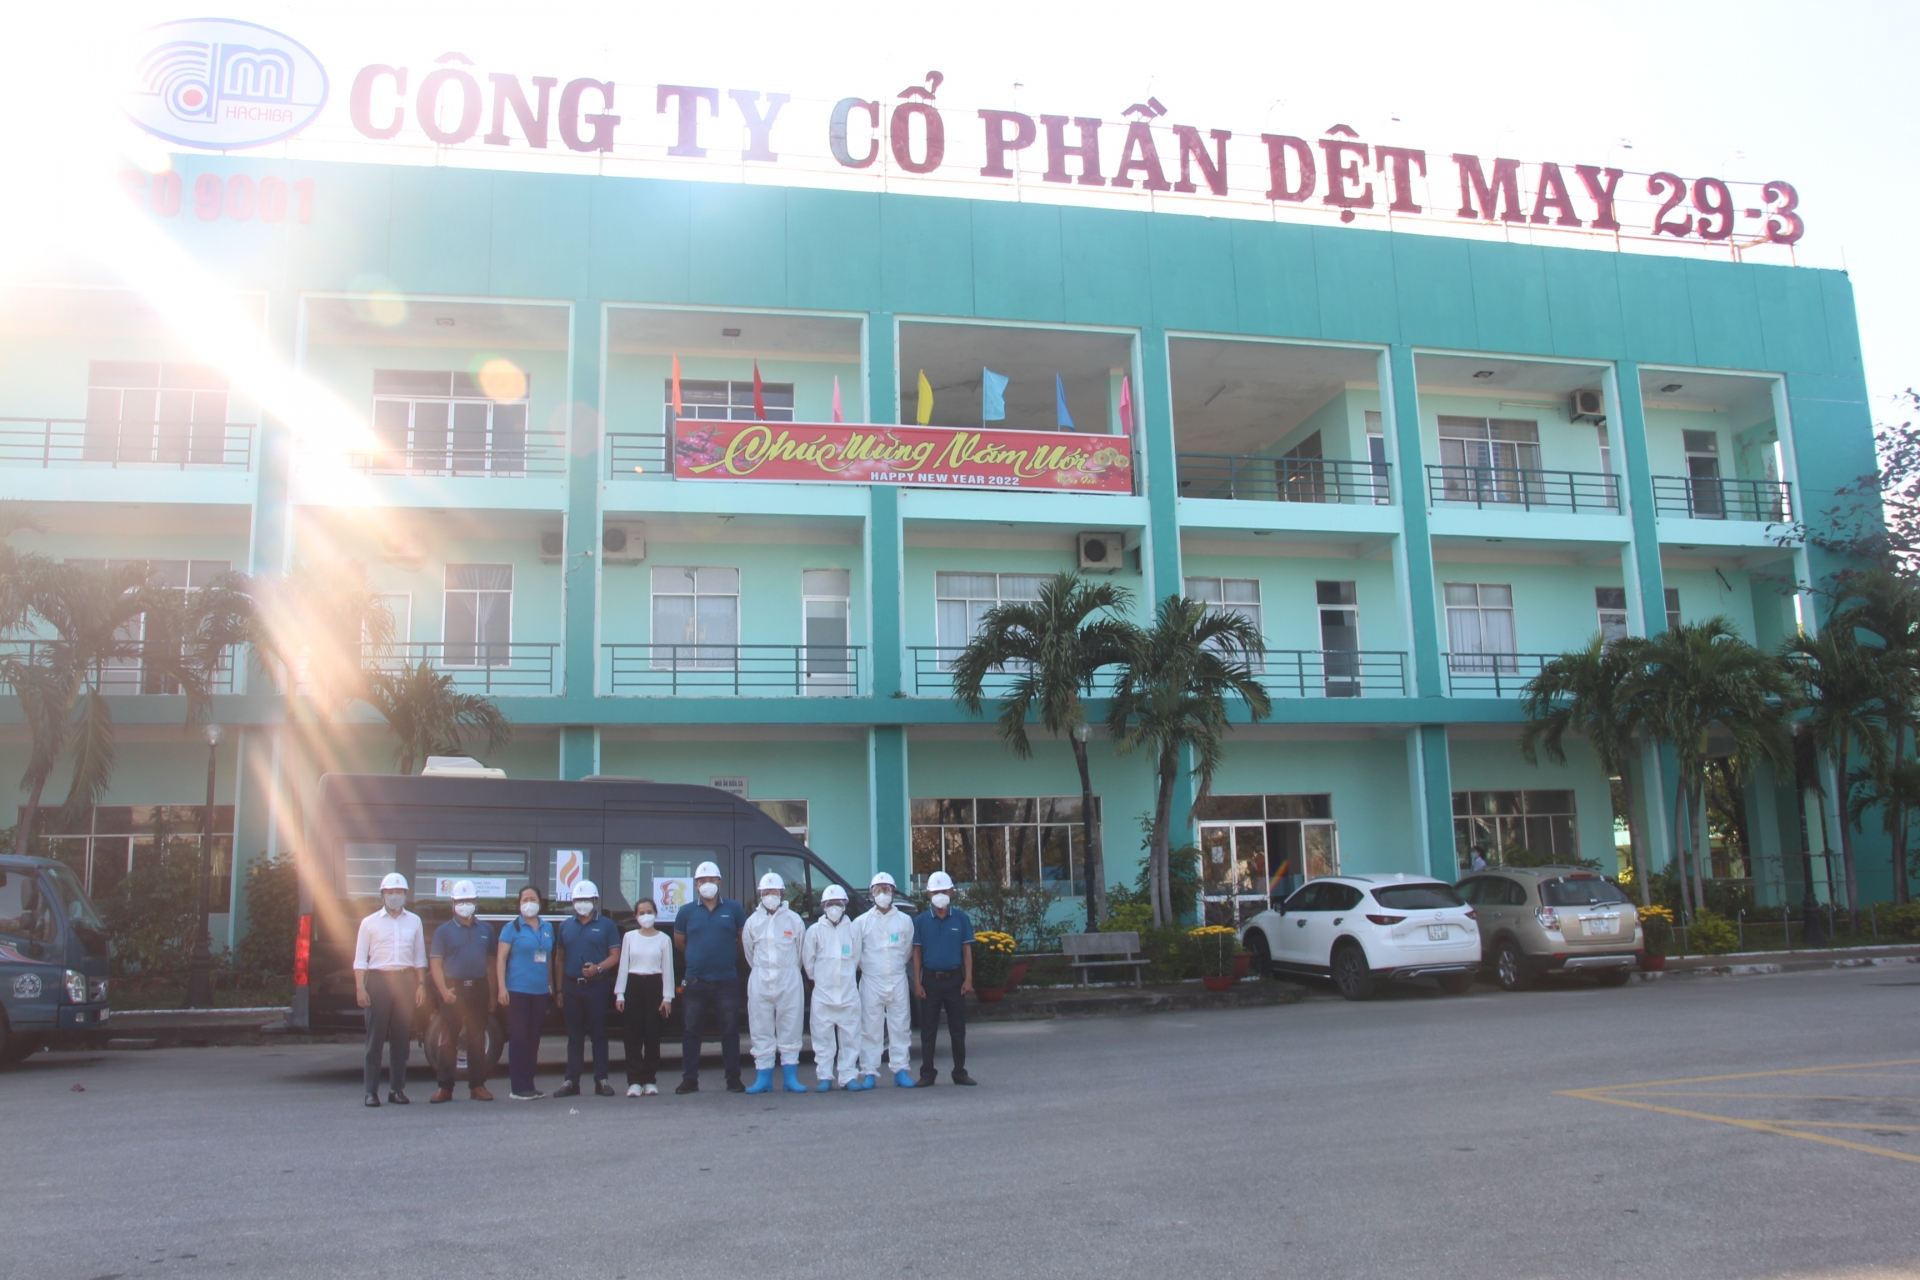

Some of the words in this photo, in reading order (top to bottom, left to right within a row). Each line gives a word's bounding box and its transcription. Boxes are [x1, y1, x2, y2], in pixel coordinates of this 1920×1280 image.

[225, 105, 293, 123] HACHIBA
[349, 51, 621, 153] CÔNG
[656, 84, 790, 162] TY
[828, 70, 945, 174] CỔ
[978, 96, 1231, 196] PHẦN
[1261, 124, 1427, 224] DỆT
[1453, 153, 1624, 231] MAY
[1646, 171, 1805, 245] 29-3
[193, 173, 315, 224] 9001
[688, 425, 854, 476] Chúc
[838, 432, 936, 472] Mừng
[932, 431, 1047, 478] Năm
[1024, 444, 1107, 474] Mới
[870, 471, 914, 482] HAPPY
[917, 473, 948, 483] NEW
[952, 474, 985, 484] YEAR
[988, 475, 1020, 486] 2022
